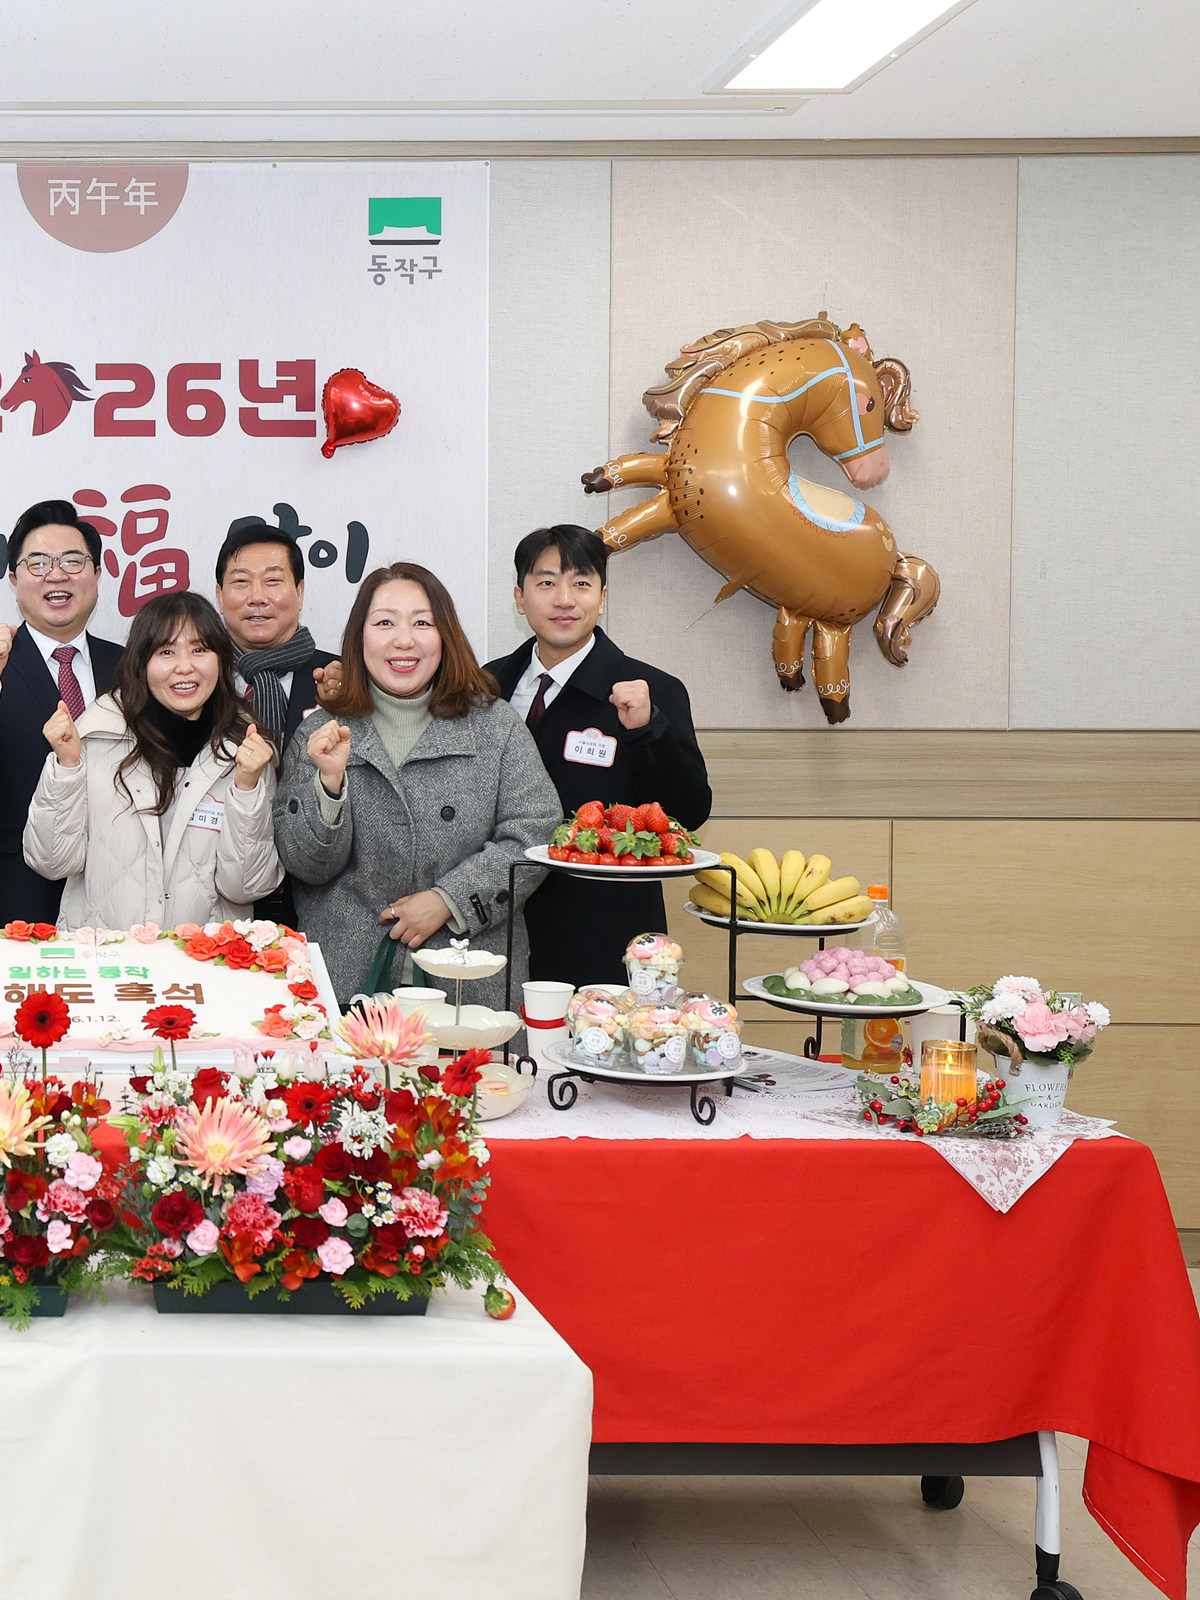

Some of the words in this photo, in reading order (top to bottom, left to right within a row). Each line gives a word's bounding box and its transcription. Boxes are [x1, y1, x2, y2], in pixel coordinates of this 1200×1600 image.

[47, 178, 159, 216] 丙午年
[367, 254, 443, 286] 동작구
[8, 965, 87, 979] 일하는
[114, 982, 205, 1005] 흑석
